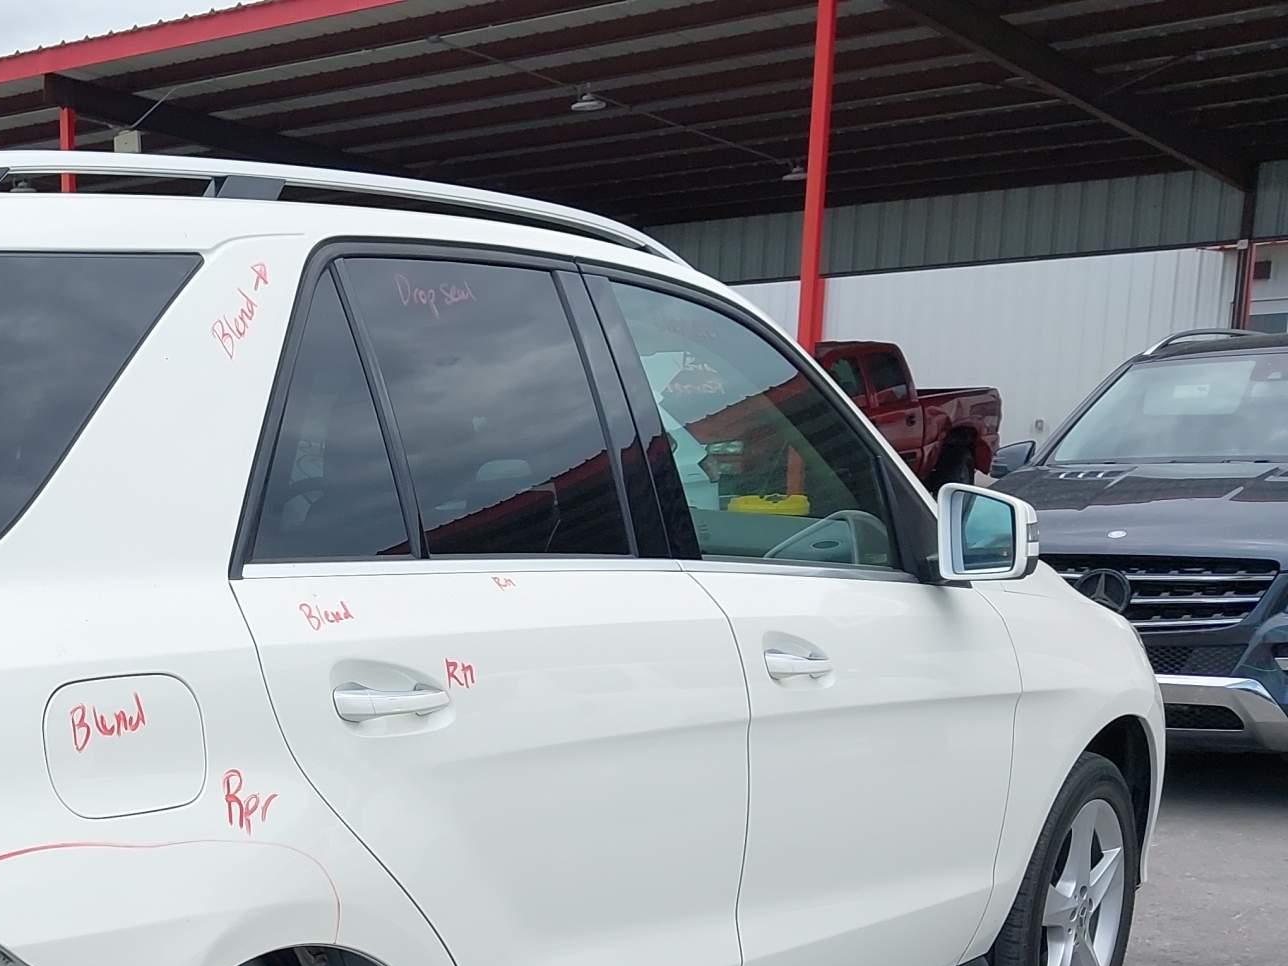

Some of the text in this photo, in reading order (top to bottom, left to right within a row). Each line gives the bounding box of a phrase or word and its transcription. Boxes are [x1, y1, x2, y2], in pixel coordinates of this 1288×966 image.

[211, 287, 258, 360] Blend
[299, 602, 355, 632] Blend
[70, 692, 147, 752] Blend
[222, 769, 279, 836] Rpr
